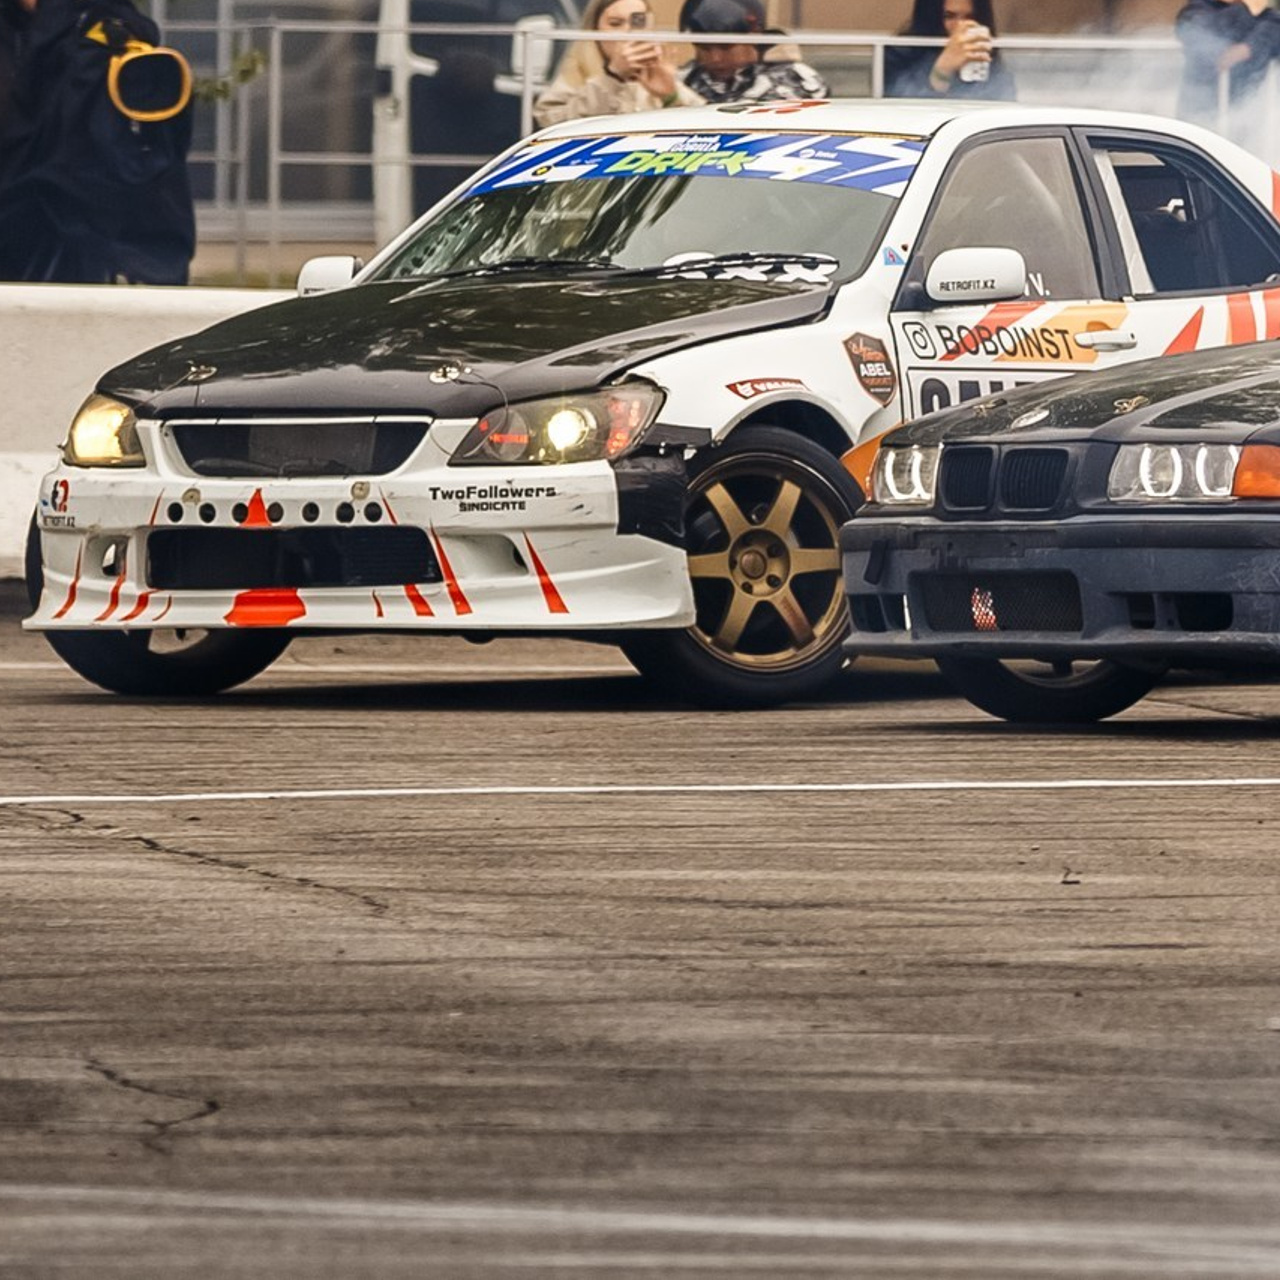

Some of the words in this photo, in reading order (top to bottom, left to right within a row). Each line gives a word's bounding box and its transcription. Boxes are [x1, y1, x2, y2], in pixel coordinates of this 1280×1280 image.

[604, 150, 759, 176] DRIFT
[939, 279, 996, 291] RETROFIT.KZ
[935, 324, 1073, 360] BOBOINST
[860, 362, 892, 377] ABEL
[429, 485, 557, 500] TwoFollowers
[459, 501, 526, 512] SINDICATE
